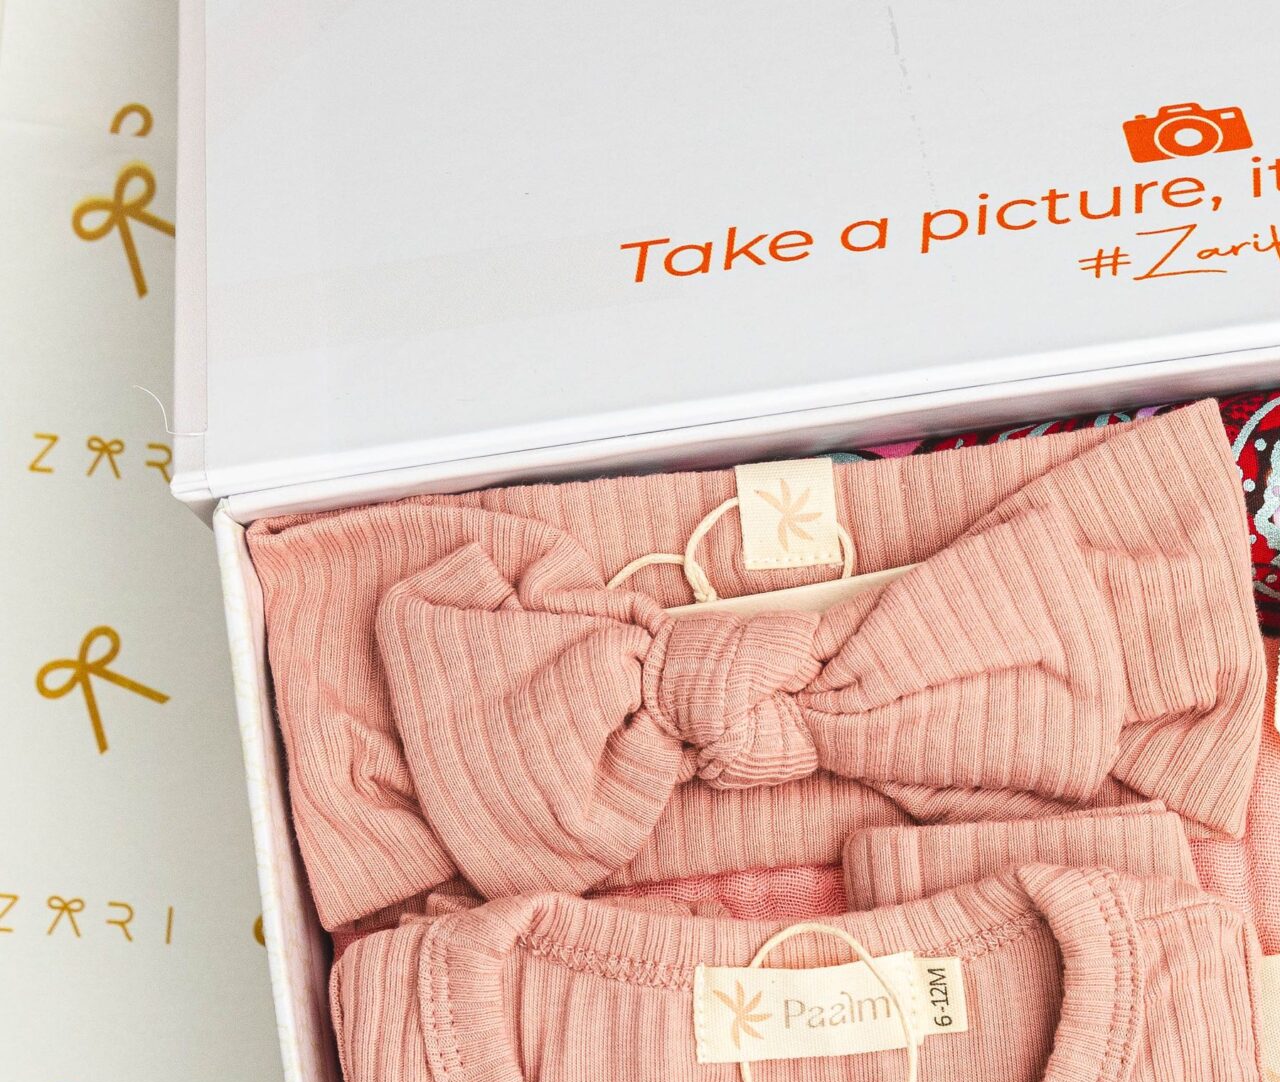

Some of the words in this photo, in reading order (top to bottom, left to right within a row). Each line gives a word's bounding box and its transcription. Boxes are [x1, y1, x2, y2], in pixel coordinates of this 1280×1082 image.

[620, 226, 814, 283] Take
[840, 217, 889, 252] a
[921, 175, 1222, 254] picture,
[28, 432, 173, 483] ZAR
[784, 991, 893, 1030] Paalm
[927, 967, 953, 1027] 6-12M
